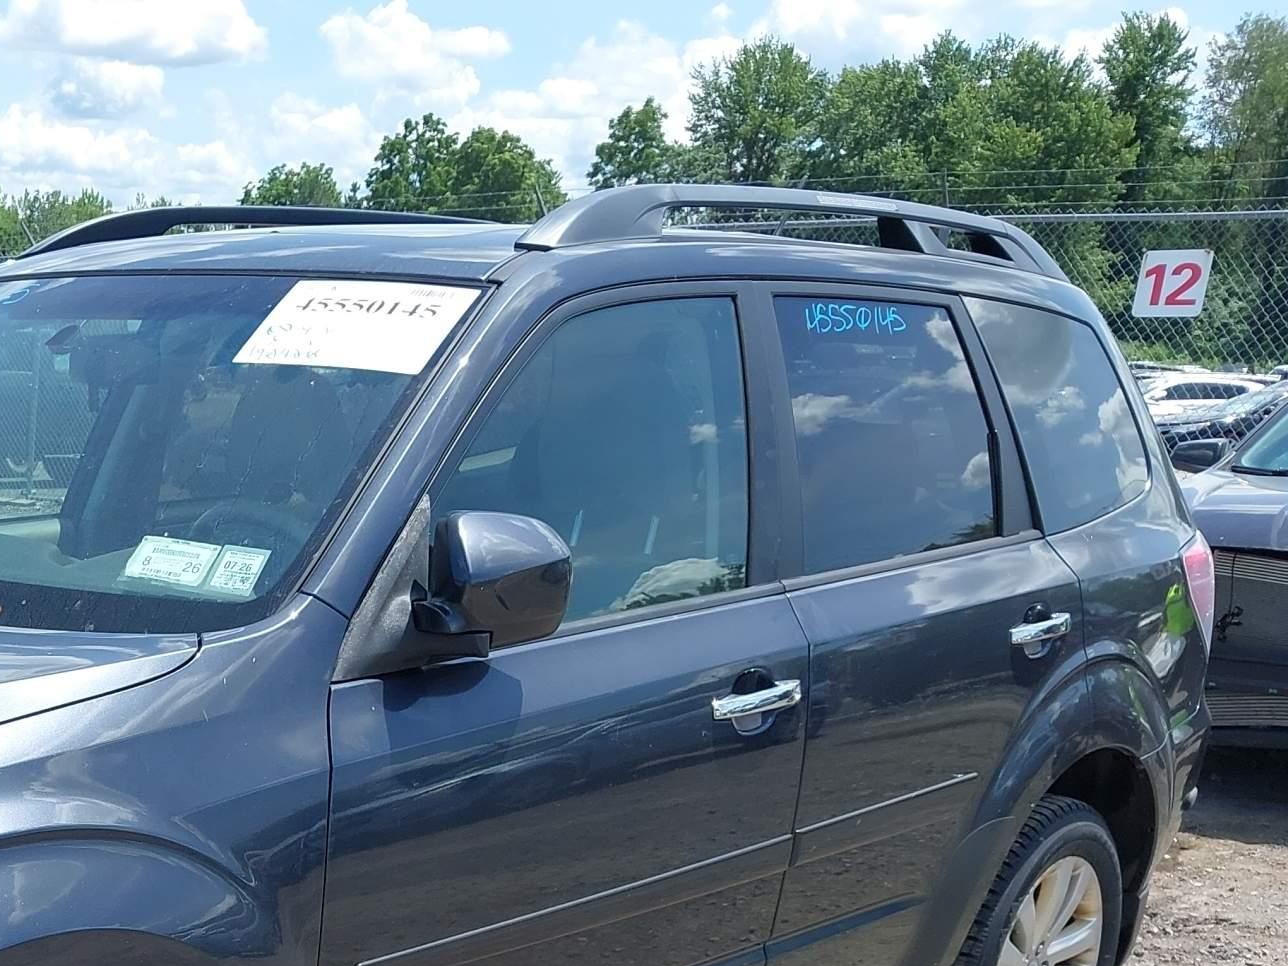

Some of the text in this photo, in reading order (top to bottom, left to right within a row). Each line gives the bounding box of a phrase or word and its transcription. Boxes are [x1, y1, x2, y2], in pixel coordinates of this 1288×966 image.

[1144, 262, 1202, 306] 12
[295, 297, 442, 318] 45550145
[142, 555, 202, 574] 8 26
